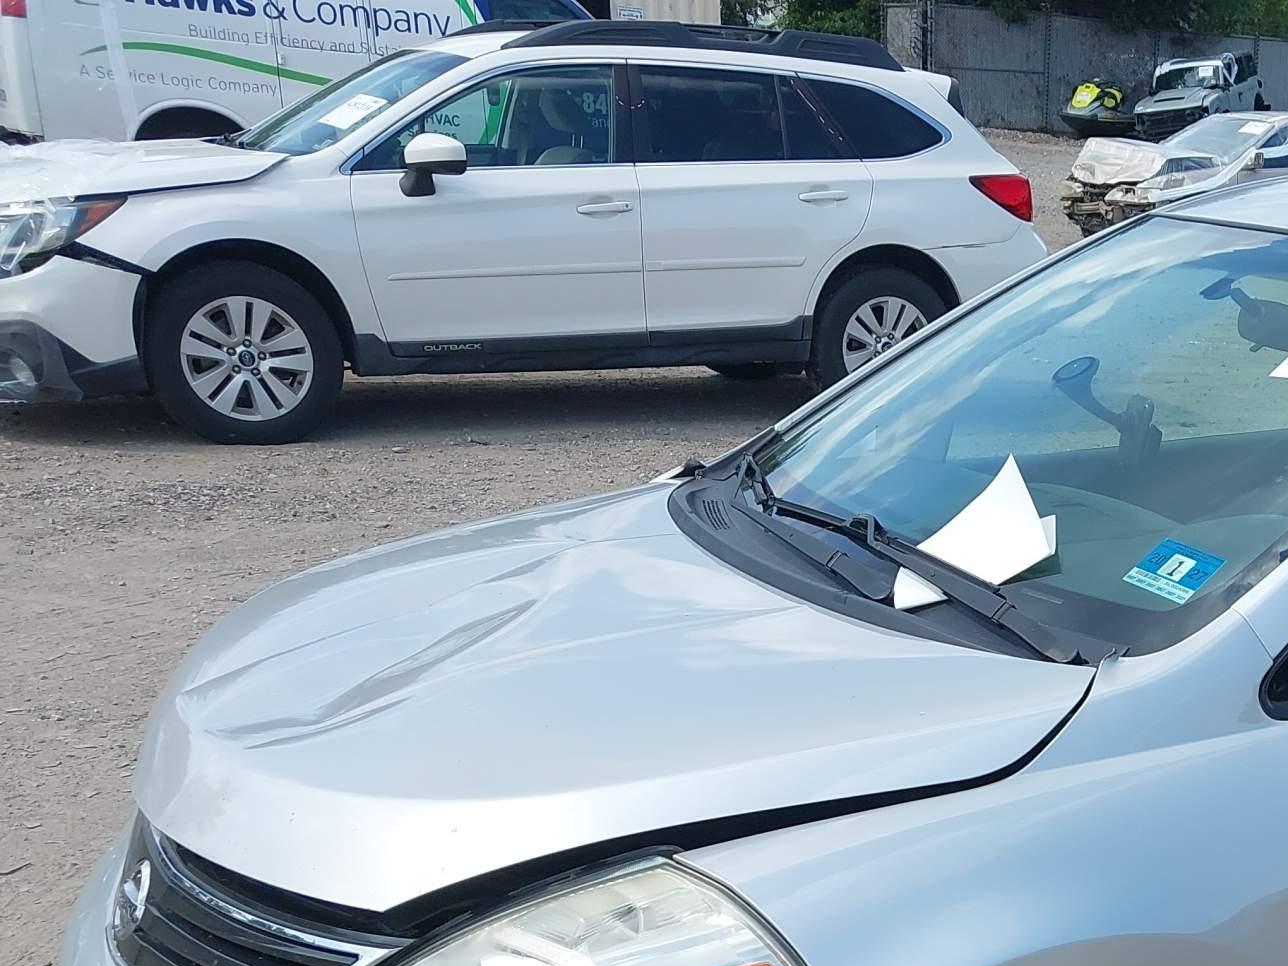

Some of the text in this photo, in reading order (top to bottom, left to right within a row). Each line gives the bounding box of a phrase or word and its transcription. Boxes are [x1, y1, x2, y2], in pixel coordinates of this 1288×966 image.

[263, 1, 289, 21] &
[293, 0, 450, 38] Company
[188, 24, 249, 45] Building
[255, 31, 324, 50] Efficiency
[329, 39, 355, 53] and
[80, 64, 277, 96] A Seice Logic Company
[424, 343, 482, 352] OUTBACK
